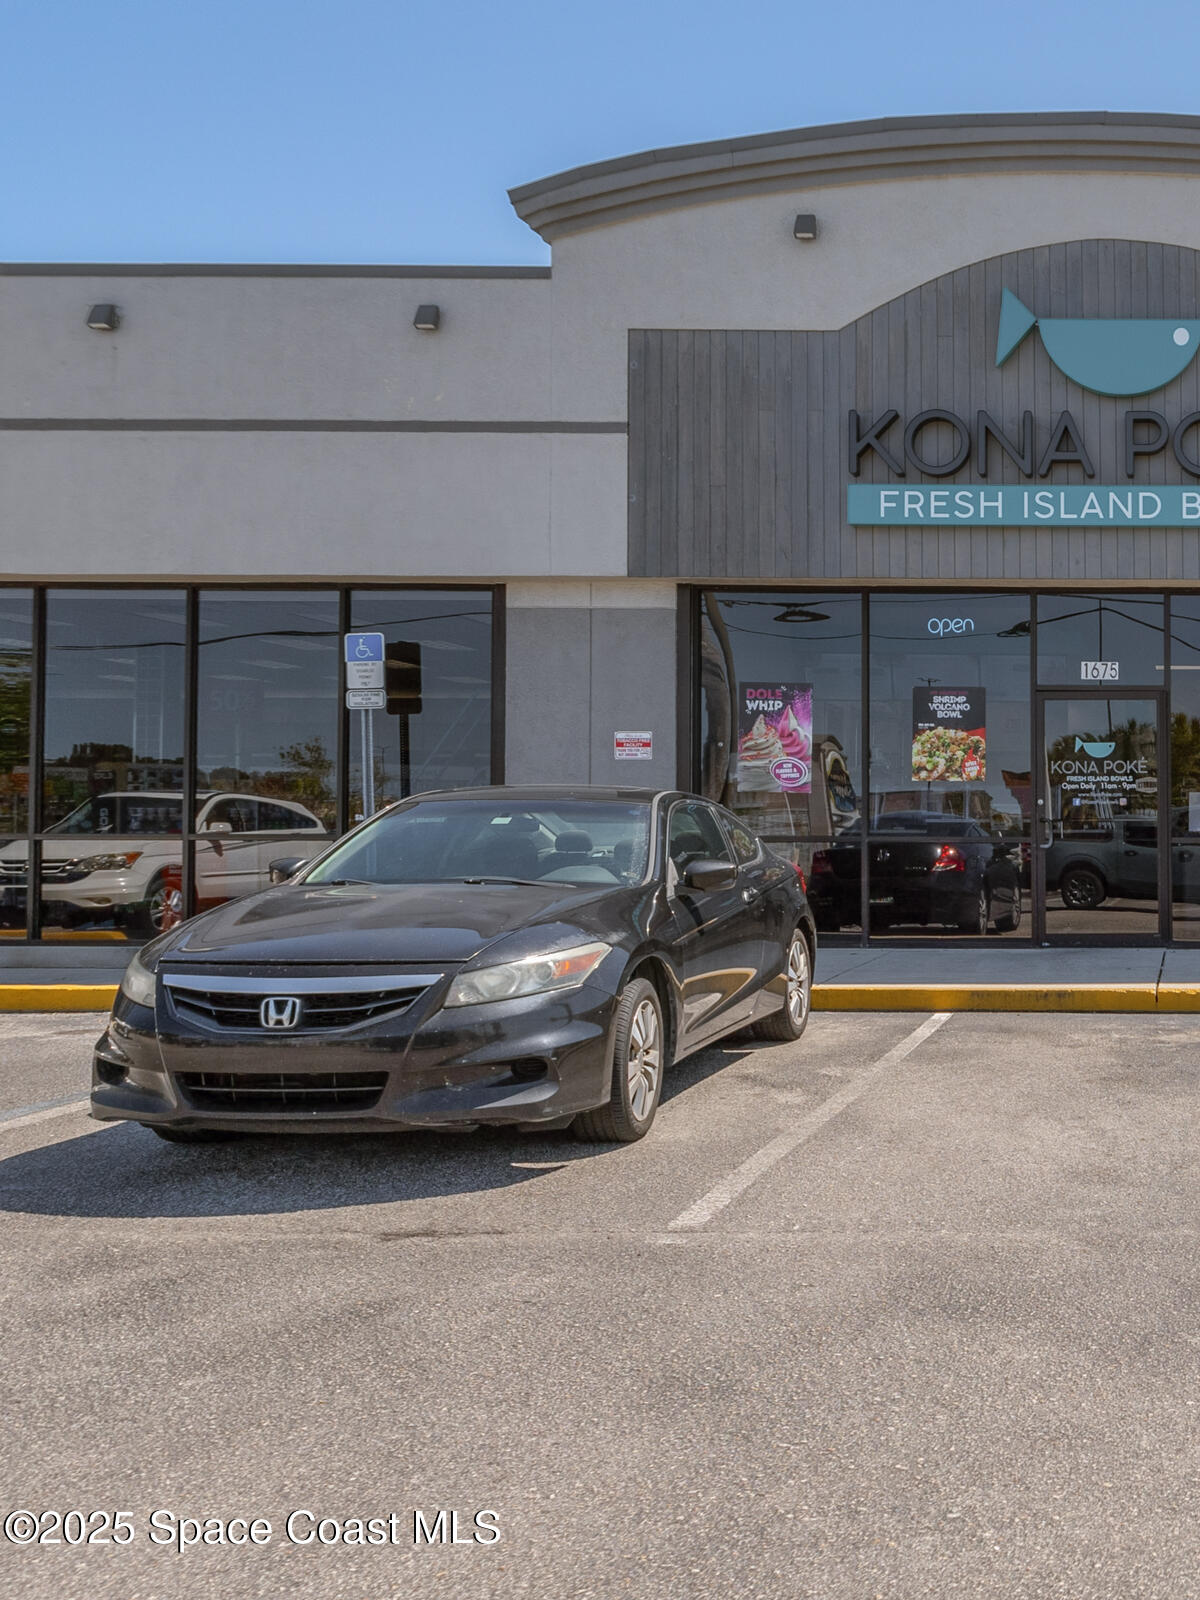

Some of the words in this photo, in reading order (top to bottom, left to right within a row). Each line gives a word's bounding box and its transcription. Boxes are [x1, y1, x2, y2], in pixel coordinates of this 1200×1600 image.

[848, 408, 1095, 478] KONA
[879, 490, 1003, 519] FRESH
[1023, 490, 1162, 519] ISLAND
[927, 617, 975, 637] open
[1082, 662, 1118, 679] 1675
[746, 689, 782, 699] DOLE
[932, 695, 967, 704] SHRIMP
[746, 700, 783, 711] WHIP
[928, 703, 970, 711] VOLCANO
[937, 710, 963, 719] BOWL
[1050, 760, 1099, 775] KONA
[1103, 756, 1149, 774] POKÉ
[1061, 782, 1079, 790] Open
[1080, 781, 1096, 790] Daily
[1122, 782, 1137, 790] 9pm
